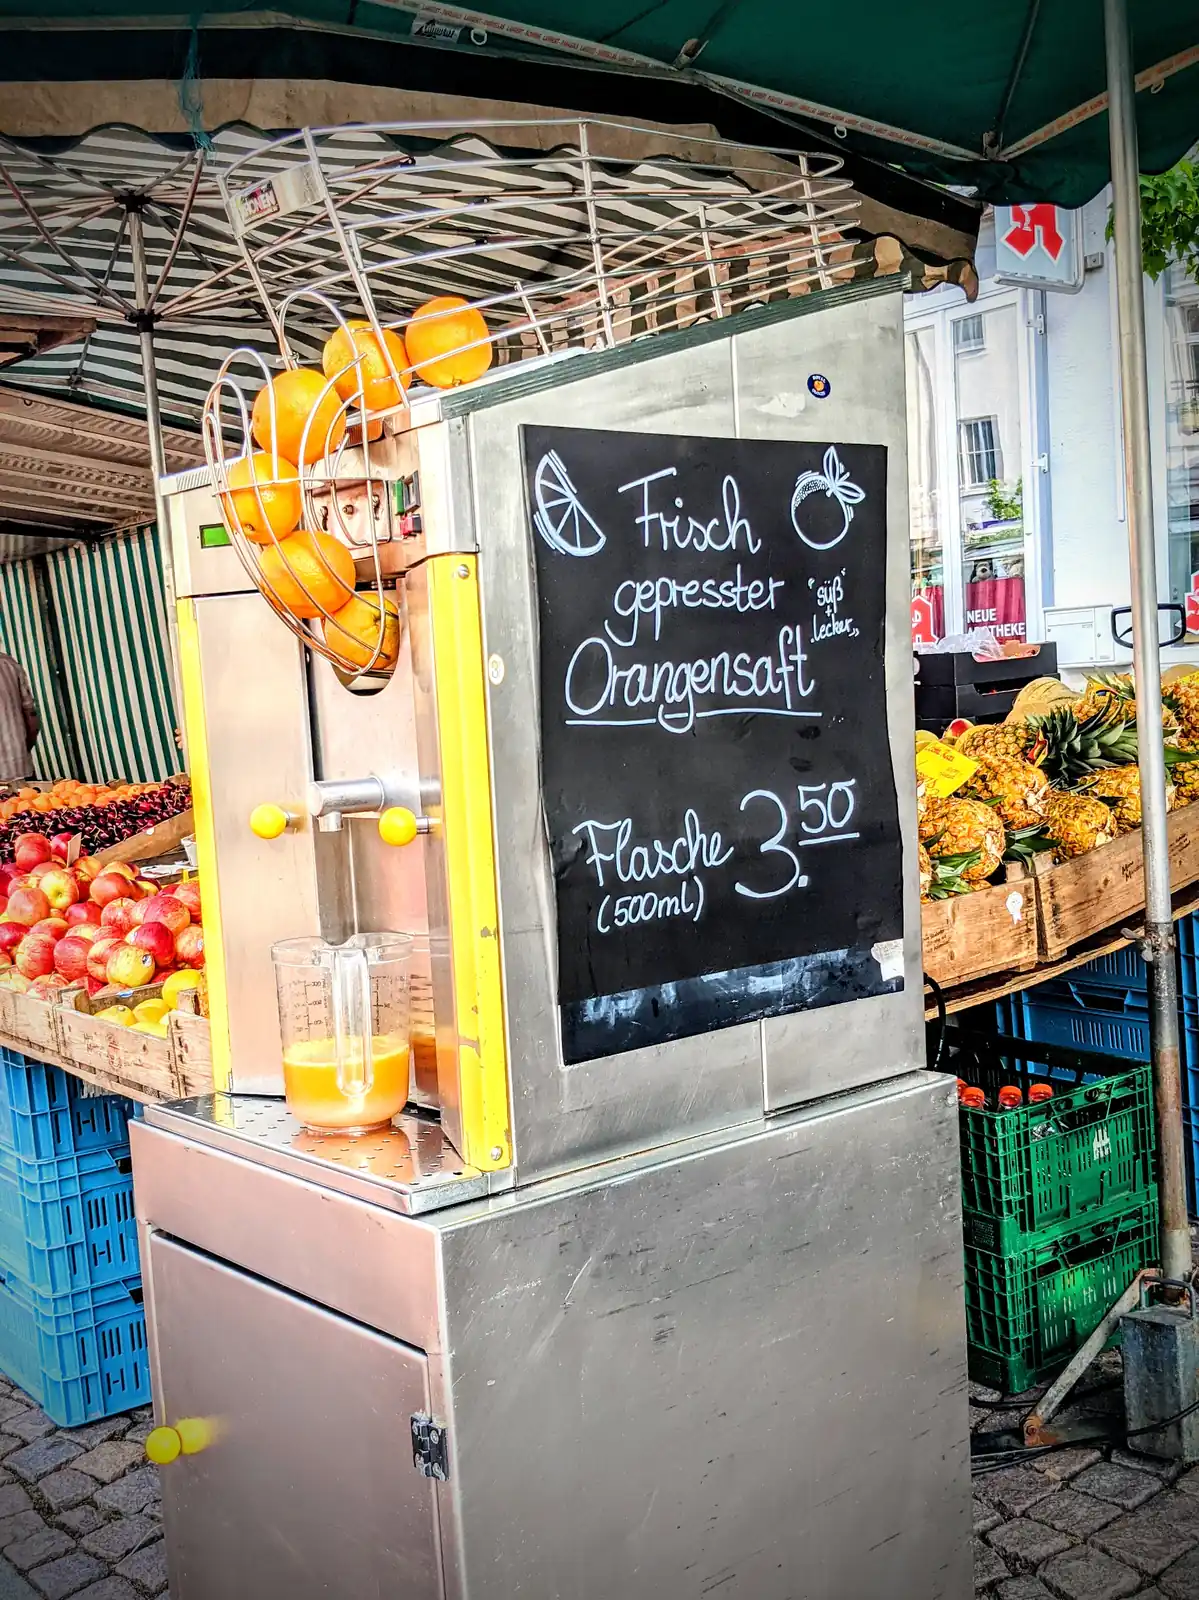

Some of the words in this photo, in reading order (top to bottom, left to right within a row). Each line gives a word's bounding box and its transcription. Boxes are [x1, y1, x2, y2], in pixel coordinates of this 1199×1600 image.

[618, 467, 761, 554] Frisch
[604, 563, 784, 646] gepresster
[966, 608, 997, 623] NEUE
[967, 622, 1026, 638] ATHEKE
[565, 625, 815, 733] Orangensaft
[572, 808, 734, 887] Flasche
[597, 876, 704, 933] (500ml)
